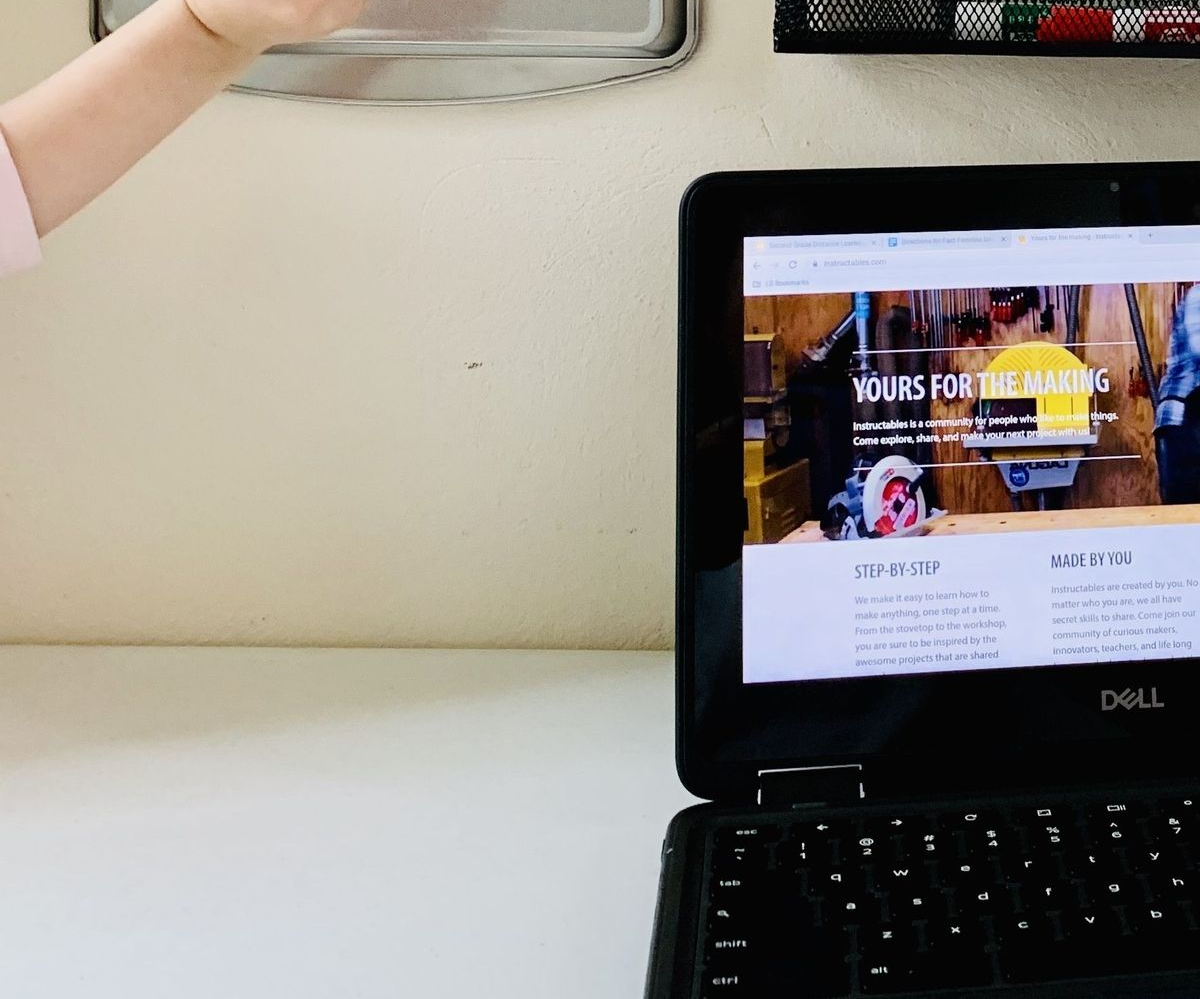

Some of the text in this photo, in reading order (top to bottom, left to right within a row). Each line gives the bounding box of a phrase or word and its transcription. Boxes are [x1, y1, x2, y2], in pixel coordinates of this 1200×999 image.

[852, 367, 1110, 403] YOURS FOR THE MAKING
[853, 420, 908, 431] Instructables
[909, 420, 917, 428] is
[925, 417, 973, 428] community
[974, 416, 987, 425] for
[989, 415, 1022, 427] people
[1023, 414, 1037, 423] who
[1090, 411, 1119, 422] things.
[853, 437, 879, 446] Come
[880, 435, 914, 446] explore,
[916, 433, 941, 444] share,
[942, 432, 959, 442] and
[960, 430, 984, 440] make
[985, 431, 1004, 442] your
[1005, 430, 1025, 439] next
[1051, 551, 1132, 568] MADE BY YOU
[855, 561, 940, 579] STEP-BY-STEP
[1051, 584, 1105, 593] Instructables
[1121, 581, 1153, 590] created
[1155, 580, 1166, 590] by
[1166, 581, 1185, 590] you.
[1186, 579, 1199, 587] No
[854, 590, 990, 605] We make it easy to learn how to
[855, 611, 879, 620] make
[881, 609, 921, 620] anything,
[942, 608, 960, 617] step
[961, 606, 970, 614] at
[979, 605, 1000, 613] time.
[855, 620, 1007, 635] From the stovetop to the workshop,
[1052, 630, 1101, 639] community
[1102, 628, 1112, 637] of
[1146, 626, 1178, 634] makers,
[855, 644, 872, 653] you
[920, 639, 932, 647] be
[933, 636, 968, 648] inspired
[970, 636, 981, 647] by
[983, 635, 997, 643] the
[1053, 640, 1192, 655] innovators, teachers, and life long
[855, 650, 999, 666] awesome projects that are shared
[1101, 687, 1165, 711] DELL
[719, 879, 741, 887] tab
[715, 939, 747, 948] shift
[870, 966, 889, 975] alt
[712, 975, 739, 985] ctrl
